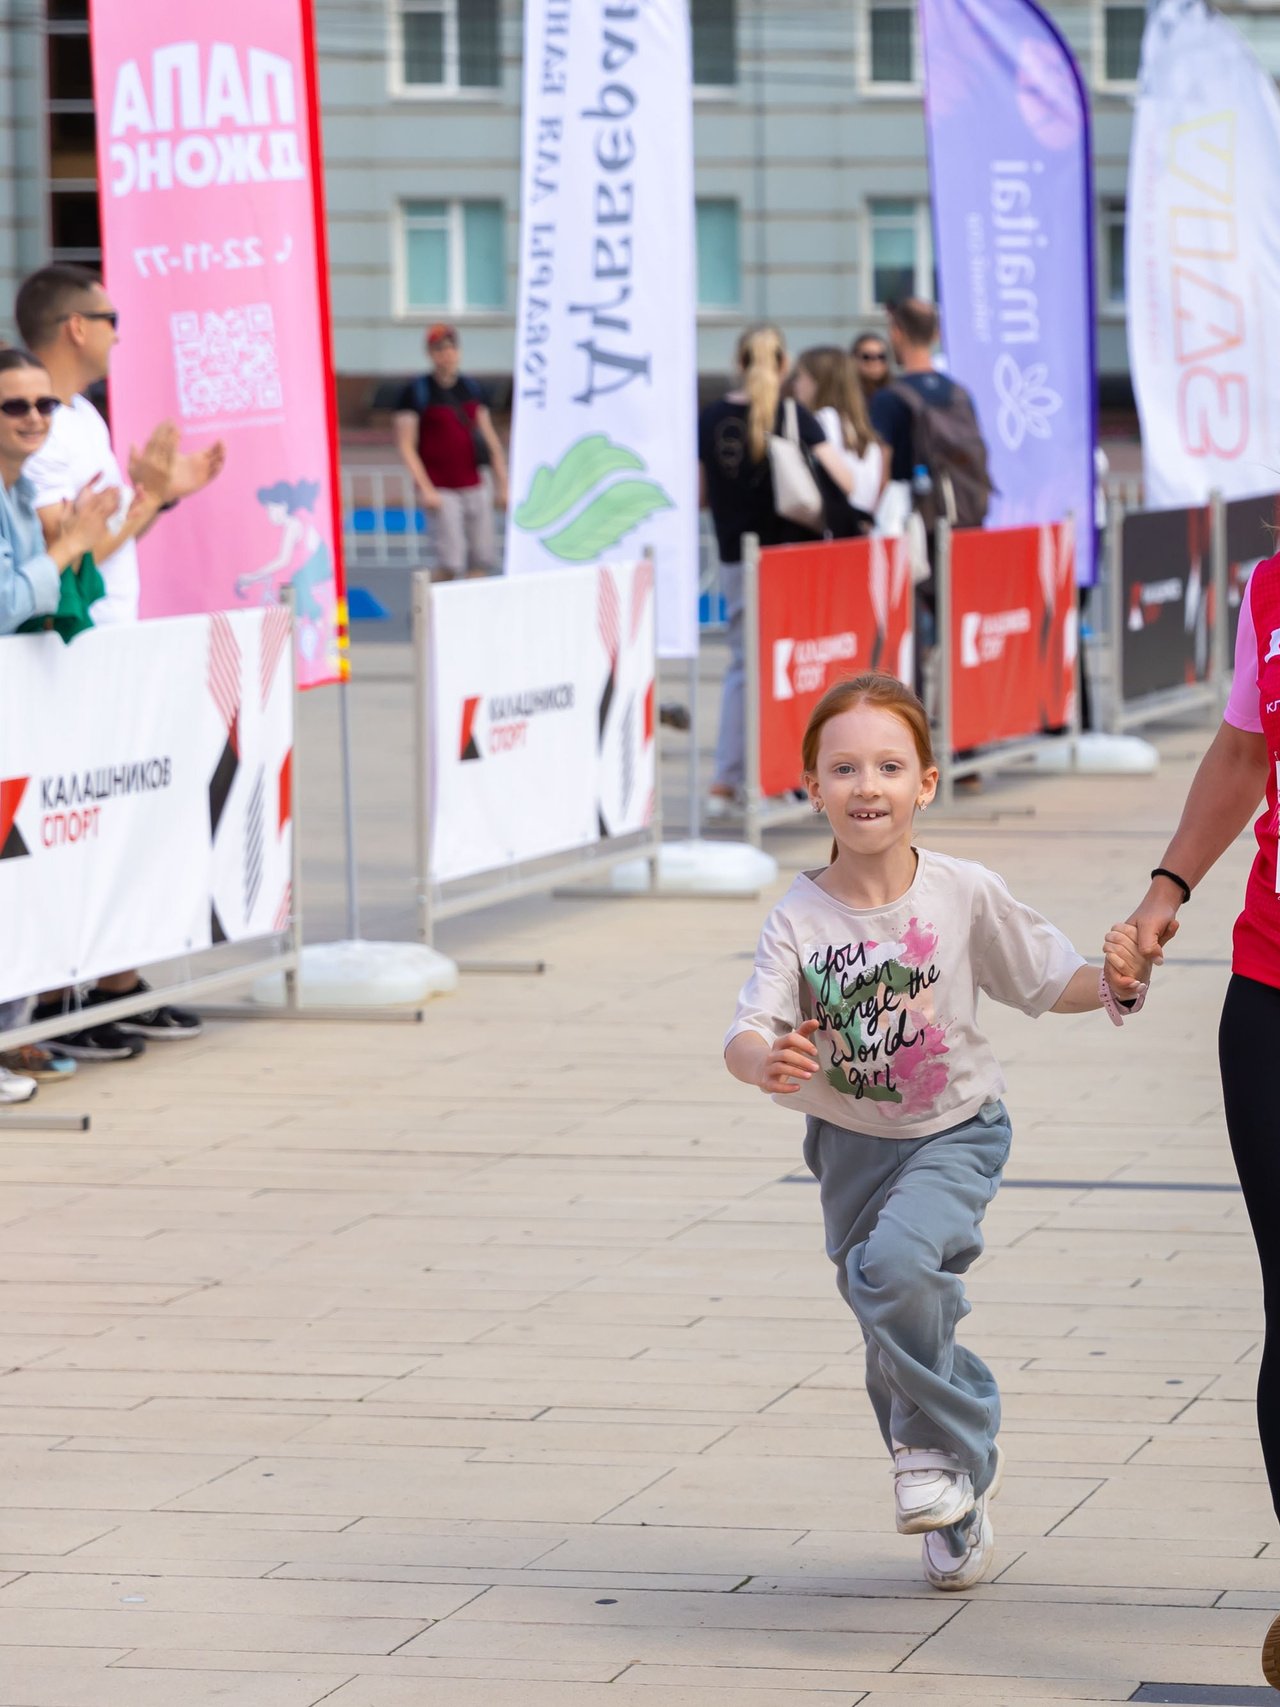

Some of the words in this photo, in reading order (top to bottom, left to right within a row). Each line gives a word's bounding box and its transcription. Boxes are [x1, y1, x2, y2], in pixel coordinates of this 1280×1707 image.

[41, 755, 172, 809] КАЛАШНИКОВ
[42, 805, 102, 847] СПОРТ
[905, 964, 941, 999] the
[849, 1063, 897, 1099] girl
